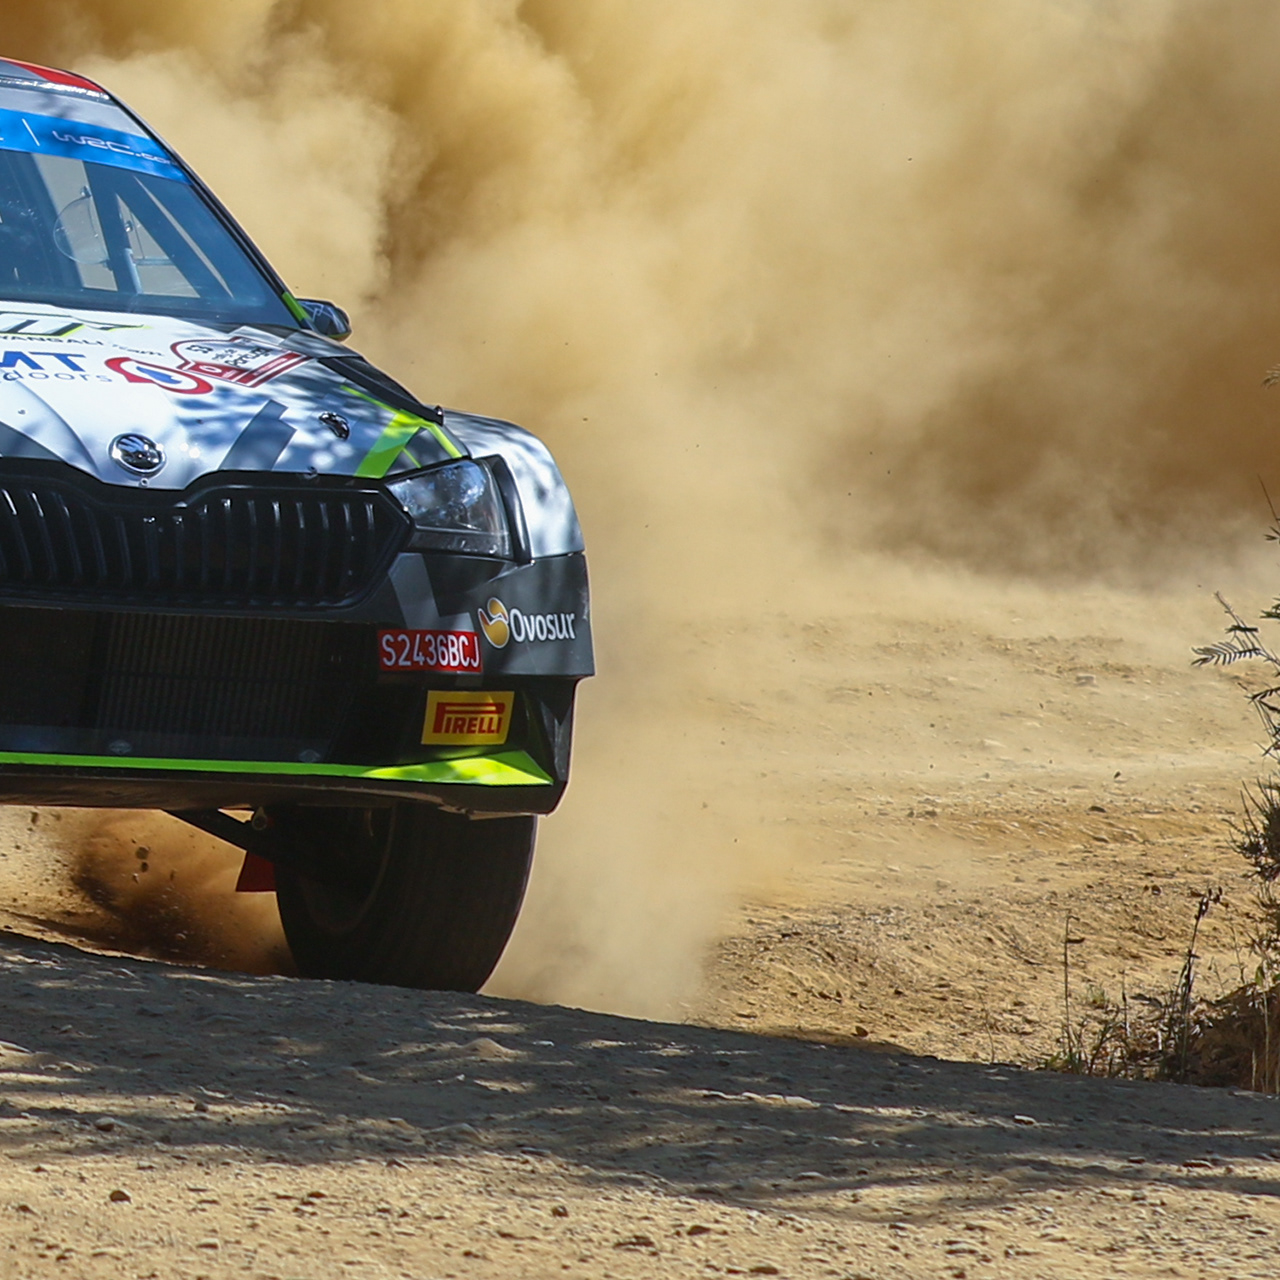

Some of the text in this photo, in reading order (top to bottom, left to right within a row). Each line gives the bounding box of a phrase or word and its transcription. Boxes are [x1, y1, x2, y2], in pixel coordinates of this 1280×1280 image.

[509, 608, 576, 643] Ovosur
[382, 633, 480, 668] S2436BCJ
[432, 702, 507, 734] PIRELLI
